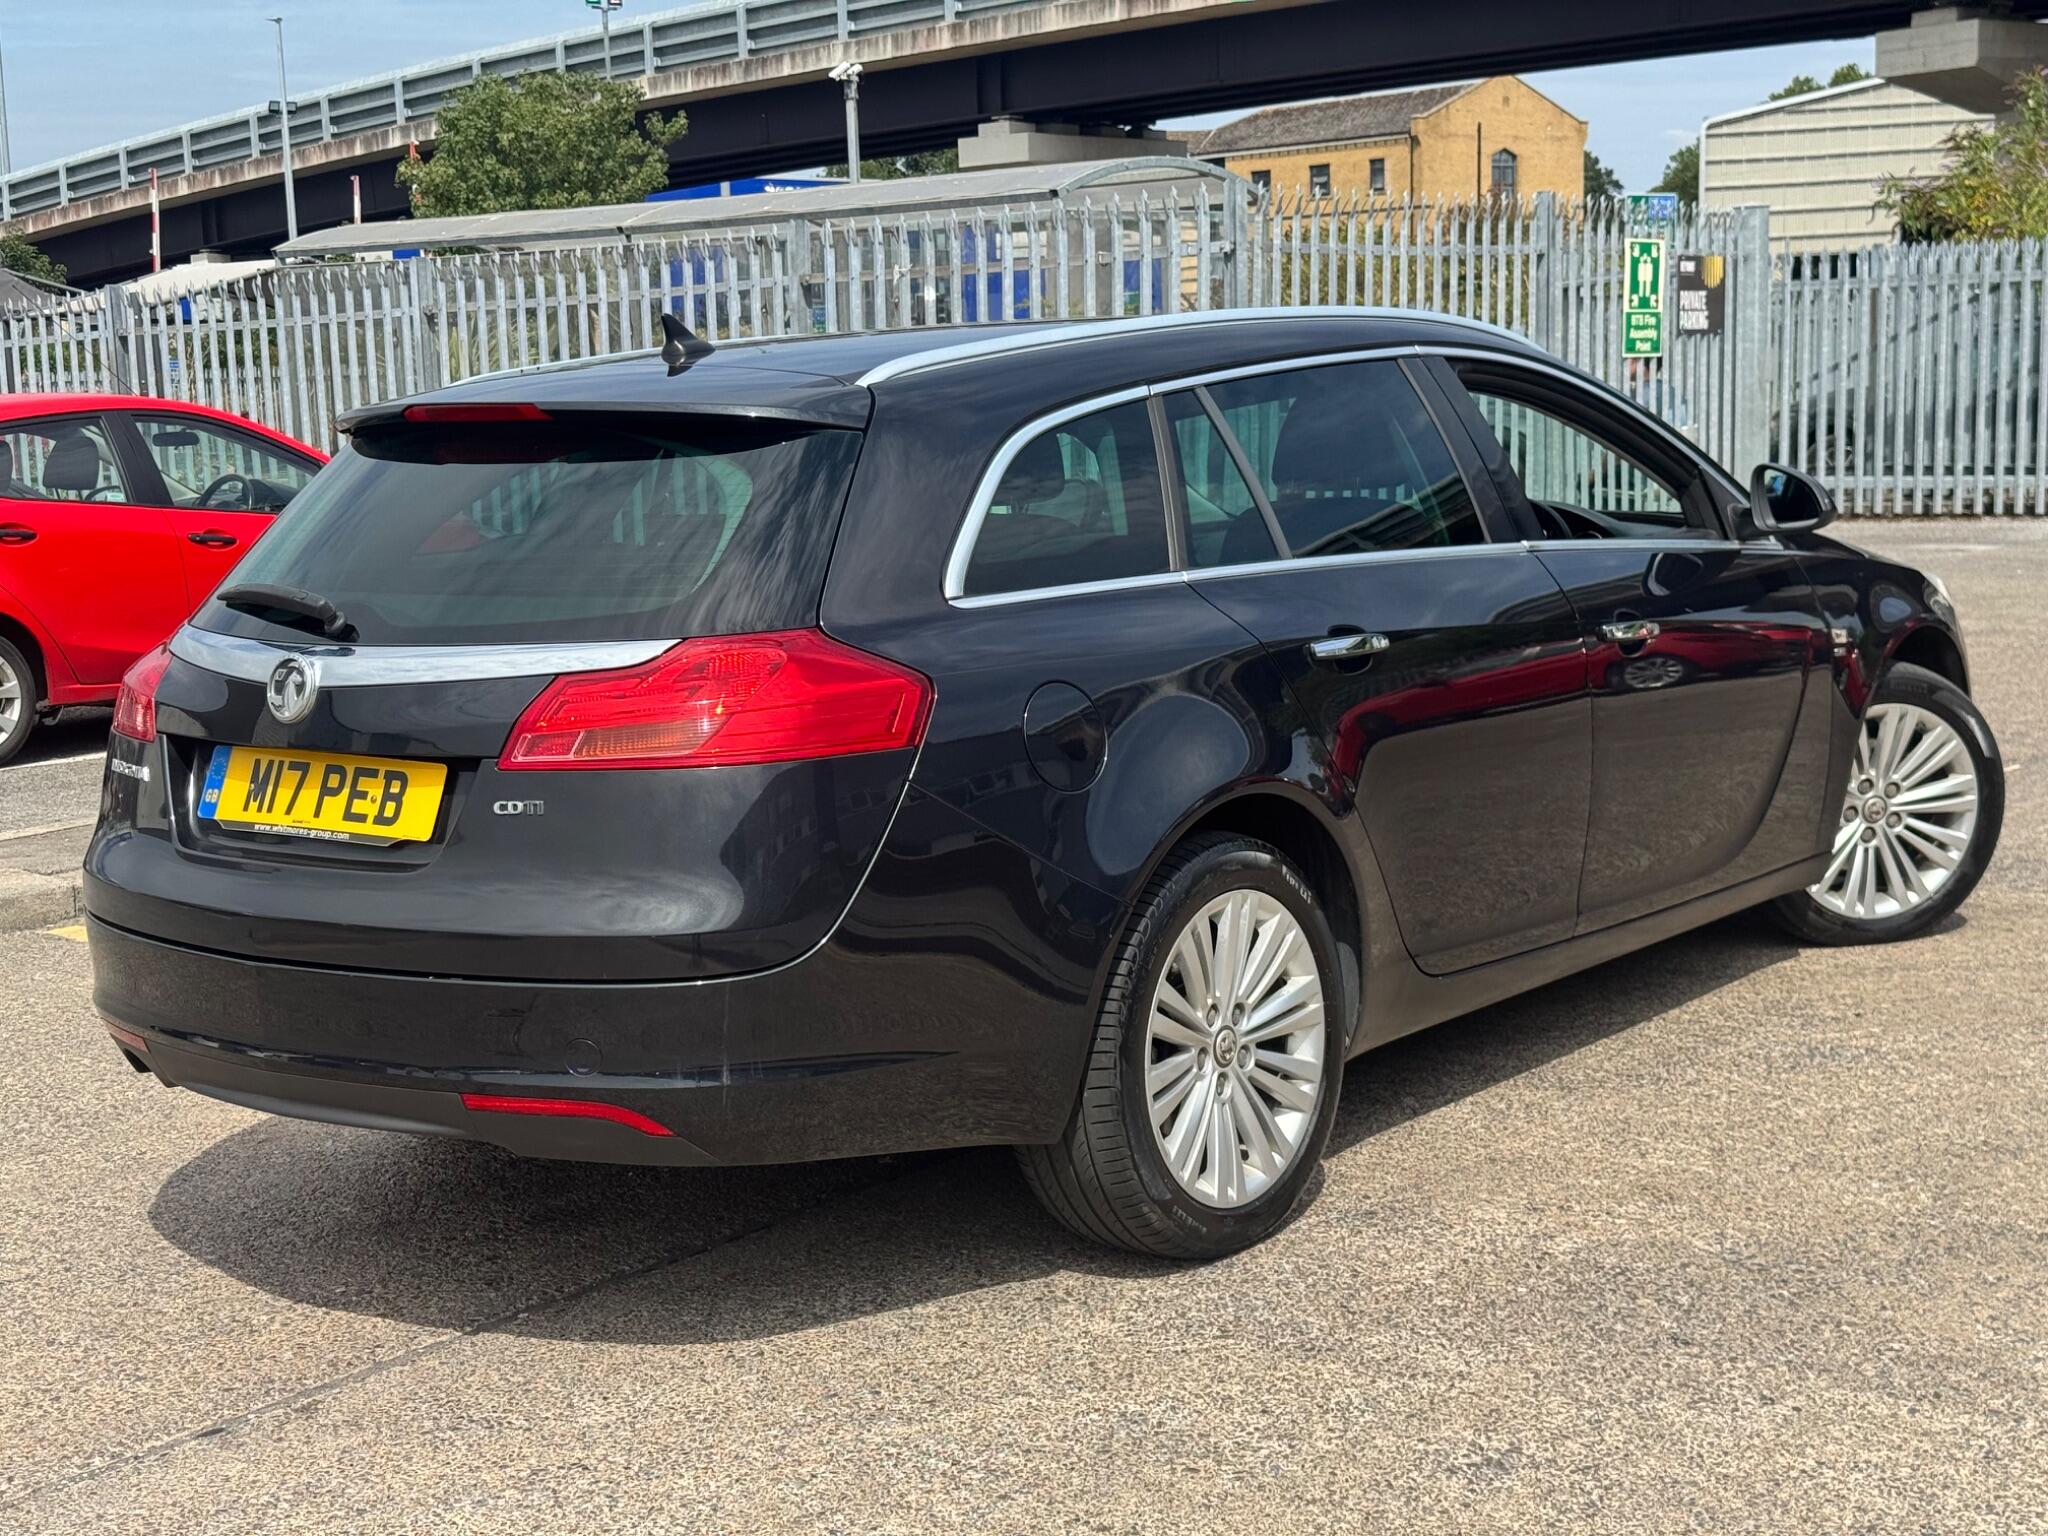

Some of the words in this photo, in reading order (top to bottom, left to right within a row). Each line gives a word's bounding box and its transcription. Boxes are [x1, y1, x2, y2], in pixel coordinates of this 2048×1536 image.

[1680, 290, 1707, 310] PRIVATE
[1644, 314, 1657, 326] Fire
[1679, 310, 1709, 330] PARKING
[1629, 328, 1658, 341] Assembly
[1635, 340, 1652, 352] Point
[205, 788, 220, 804] GB
[313, 763, 408, 827] PEB
[254, 818, 350, 840] www.whitmores-group.com
